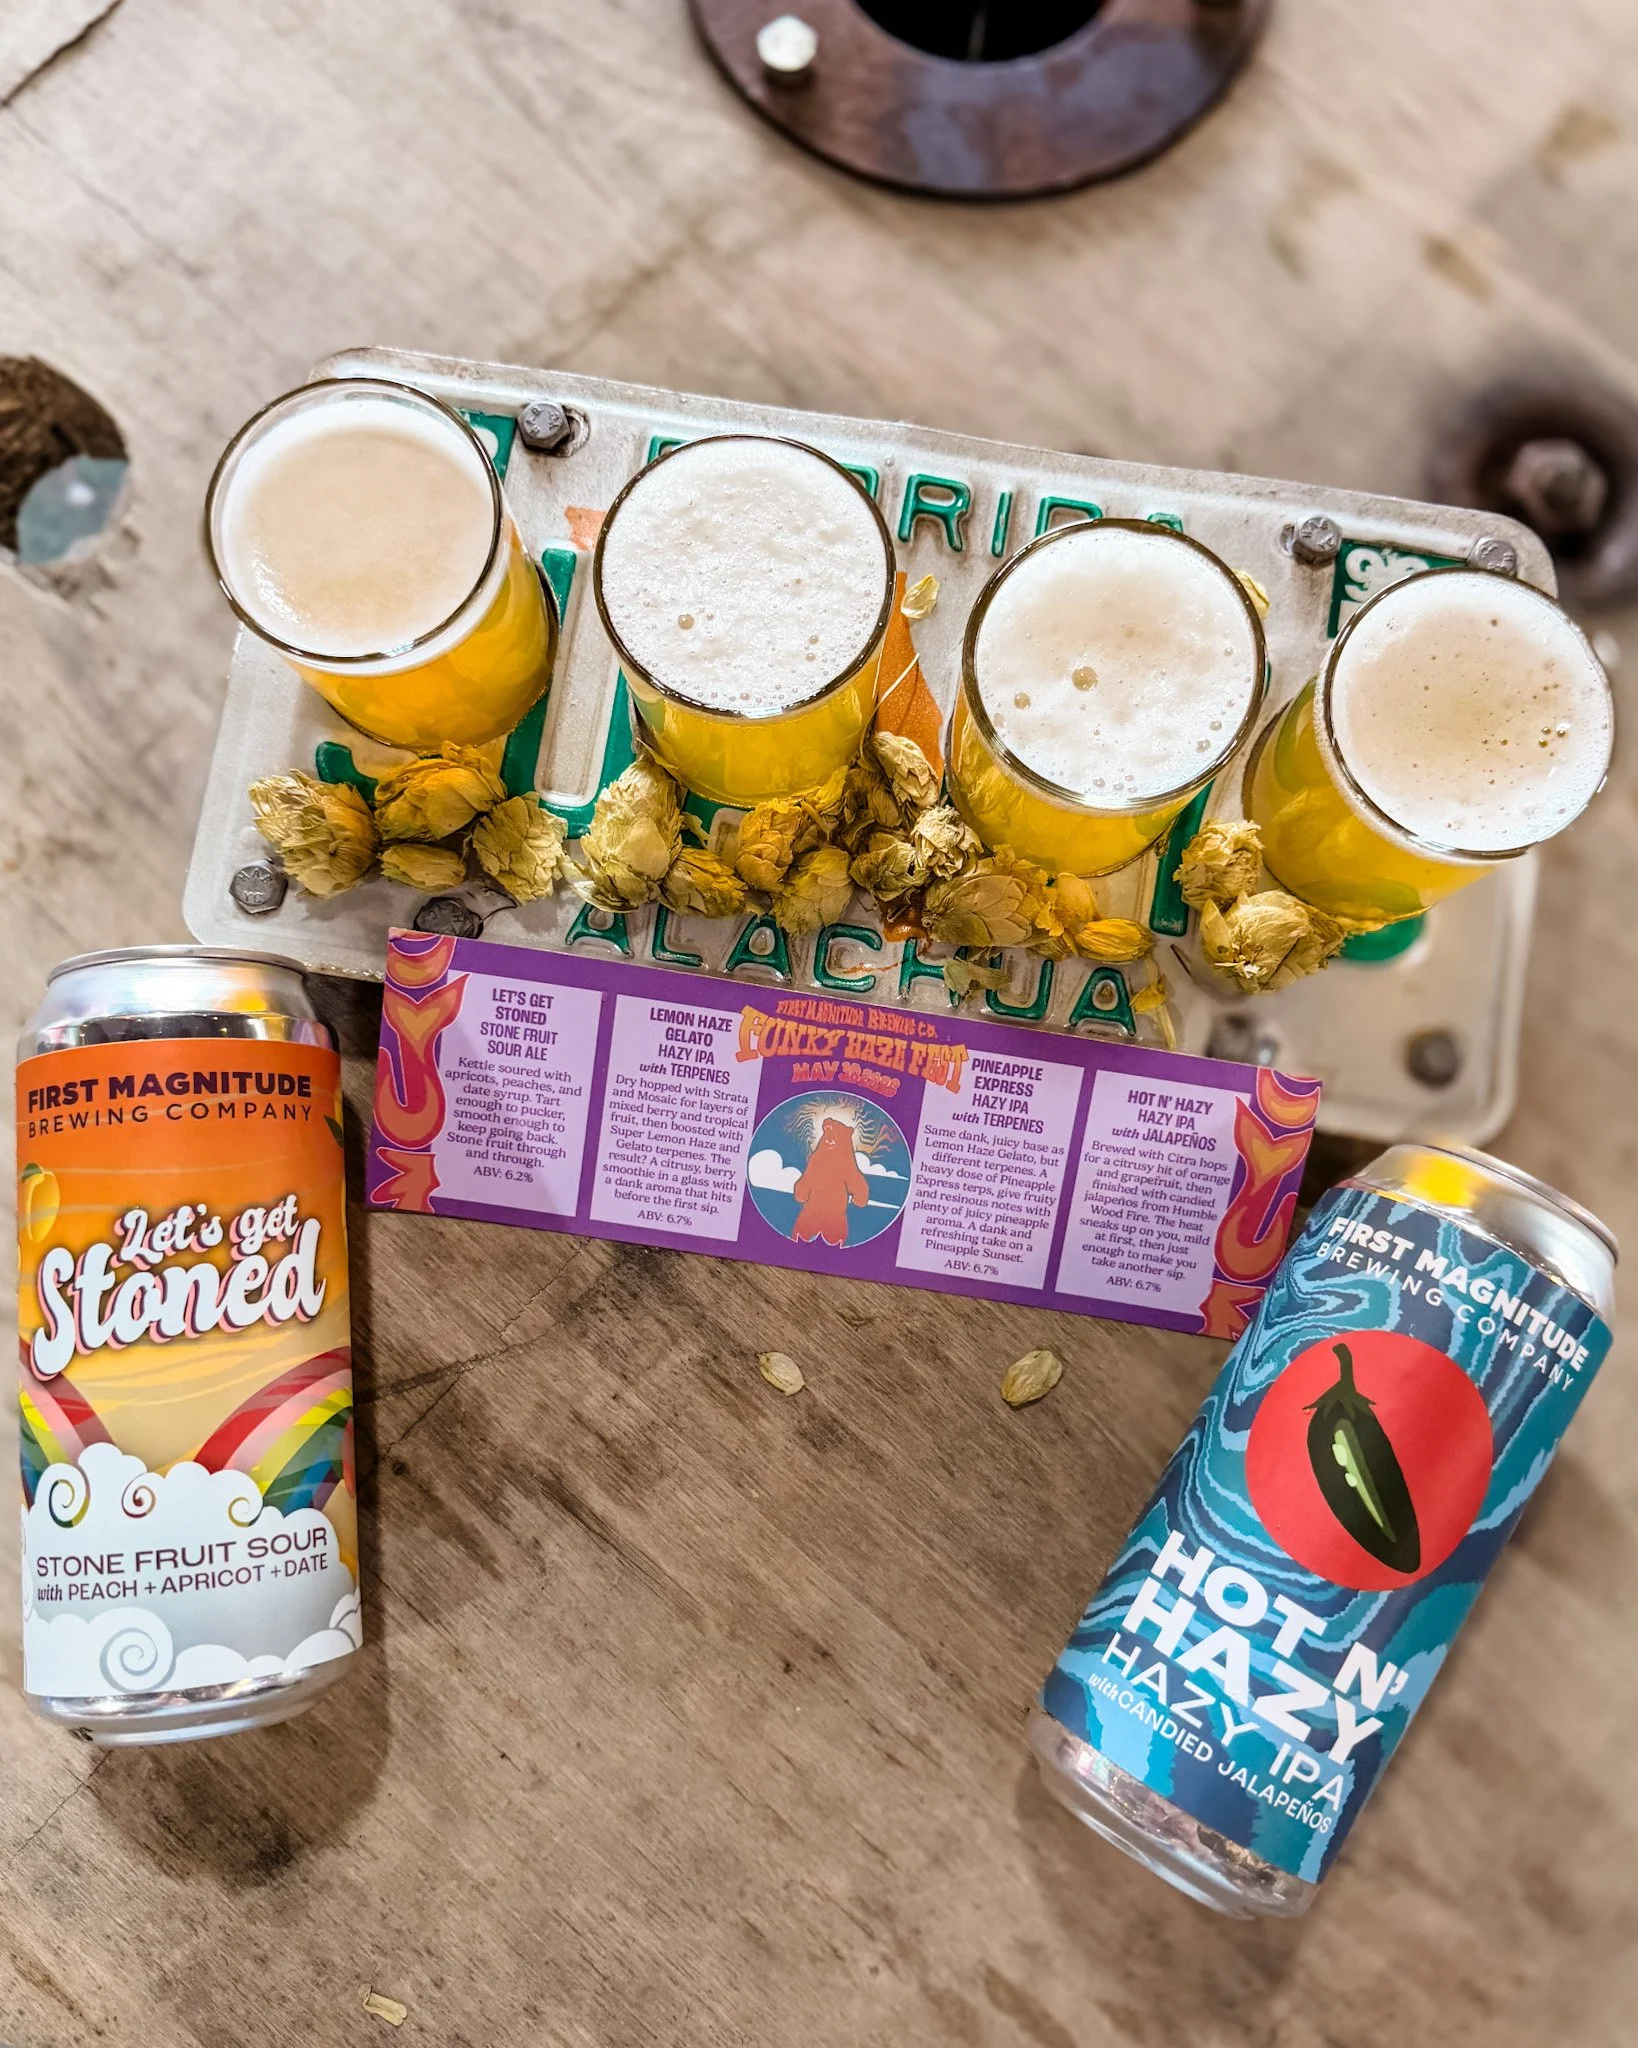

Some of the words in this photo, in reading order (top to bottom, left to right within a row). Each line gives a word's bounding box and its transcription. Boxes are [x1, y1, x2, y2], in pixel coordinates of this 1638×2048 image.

[492, 988, 526, 1004] LET'S
[529, 993, 553, 1008] GET
[495, 1005, 546, 1024] STONED
[649, 1007, 694, 1025] LEMON
[697, 1014, 732, 1031] HAZE
[776, 999, 804, 1016] FIRST
[803, 1002, 864, 1027] MAGNITUDE
[867, 1007, 915, 1036] BREWING
[480, 1021, 520, 1039] STONE
[523, 1027, 557, 1044] FRUIT
[665, 1027, 713, 1046] GELATO
[487, 1039, 521, 1056] SOUR
[524, 1045, 547, 1060] ALE
[658, 1044, 692, 1060] HAZY
[694, 1049, 714, 1064] IPA
[736, 1005, 845, 1062] FUNKY
[844, 1032, 907, 1072] HAZE
[906, 1041, 969, 1094] FEST
[458, 1056, 495, 1071] Kettle
[498, 1064, 540, 1077] soured
[543, 1070, 571, 1082] with
[639, 1062, 666, 1074] with
[671, 1063, 729, 1083] TERPENES
[791, 1062, 839, 1083] MAY
[971, 1058, 1042, 1080] PINEAPPLE
[28, 1079, 99, 1113] FIRST
[108, 1071, 312, 1100] MAGNITUDE
[444, 1070, 498, 1085] apricots,
[501, 1077, 554, 1094] peaches,
[558, 1085, 581, 1096] and
[462, 1083, 490, 1096] date
[493, 1089, 531, 1103] syrup.
[535, 1093, 560, 1106] Tart
[615, 1074, 637, 1089] Dry
[639, 1077, 681, 1093] hopped
[684, 1086, 709, 1097] with
[712, 1089, 748, 1102] Strata
[974, 1075, 1033, 1096] EXPRESS
[455, 1097, 501, 1112] enough
[505, 1102, 518, 1112] to
[520, 1106, 565, 1120] pucker,
[609, 1100, 644, 1112] mixed
[646, 1104, 678, 1120] berry
[679, 1111, 702, 1121] and
[704, 1115, 748, 1129] tropical
[612, 1088, 634, 1098] and
[637, 1090, 677, 1104] Mosaic
[679, 1096, 697, 1107] for
[699, 1099, 733, 1114] layers
[735, 1106, 748, 1115] of
[972, 1093, 1007, 1109] HAZY
[1008, 1099, 1028, 1114] IPA
[1127, 1089, 1156, 1105] HOT
[1156, 1094, 1172, 1108] N'
[1174, 1097, 1213, 1114] HAZY
[28, 1105, 149, 1138] BREWING
[165, 1102, 312, 1122] COMPANY
[453, 1109, 500, 1122] smooth
[503, 1116, 549, 1131] enough
[552, 1122, 565, 1132] to
[457, 1120, 486, 1135] keep
[489, 1127, 523, 1141] going
[526, 1130, 557, 1143] back.
[610, 1111, 638, 1126] fruit,
[641, 1116, 667, 1129] then
[670, 1120, 715, 1136] boosted
[718, 1129, 743, 1140] with
[952, 1112, 979, 1123] with
[983, 1112, 1043, 1133] TERPENES
[1137, 1109, 1173, 1125] HAZY
[1175, 1114, 1194, 1130] IPA
[446, 1131, 483, 1145] Stone
[485, 1137, 513, 1149] fruit
[516, 1142, 566, 1159] through
[923, 1124, 956, 1137] Same
[958, 1129, 989, 1144] dank,
[992, 1134, 1020, 1150] juicy
[1022, 1139, 1048, 1152] base
[1050, 1146, 1064, 1155] as
[925, 1137, 963, 1151] Lemon
[966, 1143, 994, 1156] Haze
[997, 1148, 1036, 1164] Gelato,
[1039, 1154, 1059, 1166] but
[1111, 1127, 1139, 1139] with
[1142, 1128, 1216, 1150] JALAPEÑOS
[465, 1149, 489, 1159] and
[492, 1151, 544, 1168] through.
[931, 1151, 981, 1167] different
[984, 1160, 1035, 1176] terpenes.
[1038, 1168, 1047, 1178] A
[1083, 1151, 1101, 1163] for
[1102, 1157, 1110, 1165] a
[1112, 1157, 1154, 1173] citrusy
[1156, 1163, 1172, 1174] hit
[1174, 1167, 1188, 1177] of
[1189, 1171, 1230, 1185] orange
[1091, 1140, 1135, 1155] Brewed
[1138, 1149, 1164, 1160] with
[1167, 1152, 1196, 1165] Citra
[1198, 1157, 1227, 1171] hops
[473, 1165, 501, 1177] ABV:
[504, 1169, 533, 1182] 6.2%
[920, 1161, 953, 1177] heavy
[956, 1167, 983, 1180] dose
[985, 1172, 998, 1182] of
[999, 1174, 1055, 1192] Pineapple
[1096, 1168, 1118, 1179] and
[1120, 1173, 1182, 1190] grapefruit,
[1185, 1181, 1212, 1194] then
[1092, 1179, 1138, 1195] finished
[1141, 1188, 1167, 1199] with
[1168, 1194, 1215, 1207] candied
[637, 1209, 663, 1221] ABV:
[666, 1213, 692, 1225] 6.7%
[112, 1203, 224, 1270] Let's
[229, 1194, 298, 1260] get
[944, 1259, 970, 1270] ABV:
[973, 1263, 998, 1275] 6.7%
[1105, 1275, 1132, 1287] ABV:
[1135, 1279, 1161, 1292] 6.7%
[1327, 1216, 1415, 1262] FIRST
[1414, 1248, 1590, 1373] MAGNITUDE
[31, 1219, 327, 1381] Stoned
[1316, 1242, 1444, 1308] BREWING
[1455, 1304, 1574, 1393] COMPANY
[36, 1555, 124, 1578] STONE
[135, 1541, 237, 1572] FRUIT
[247, 1526, 328, 1558] SOUR
[37, 1584, 63, 1602] with
[68, 1581, 137, 1600] PEACH
[161, 1564, 265, 1594] APRICOT
[284, 1553, 328, 1578] DATE
[1150, 1529, 1328, 1660] HOT
[1332, 1641, 1410, 1712] N'
[1121, 1577, 1384, 1767] HAZY
[1100, 1632, 1261, 1748] HAZY
[1268, 1742, 1354, 1813] IPA
[1088, 1671, 1121, 1702] with
[1117, 1690, 1214, 1763] CANDIED
[1217, 1760, 1333, 1834] JALAPEÑOS
